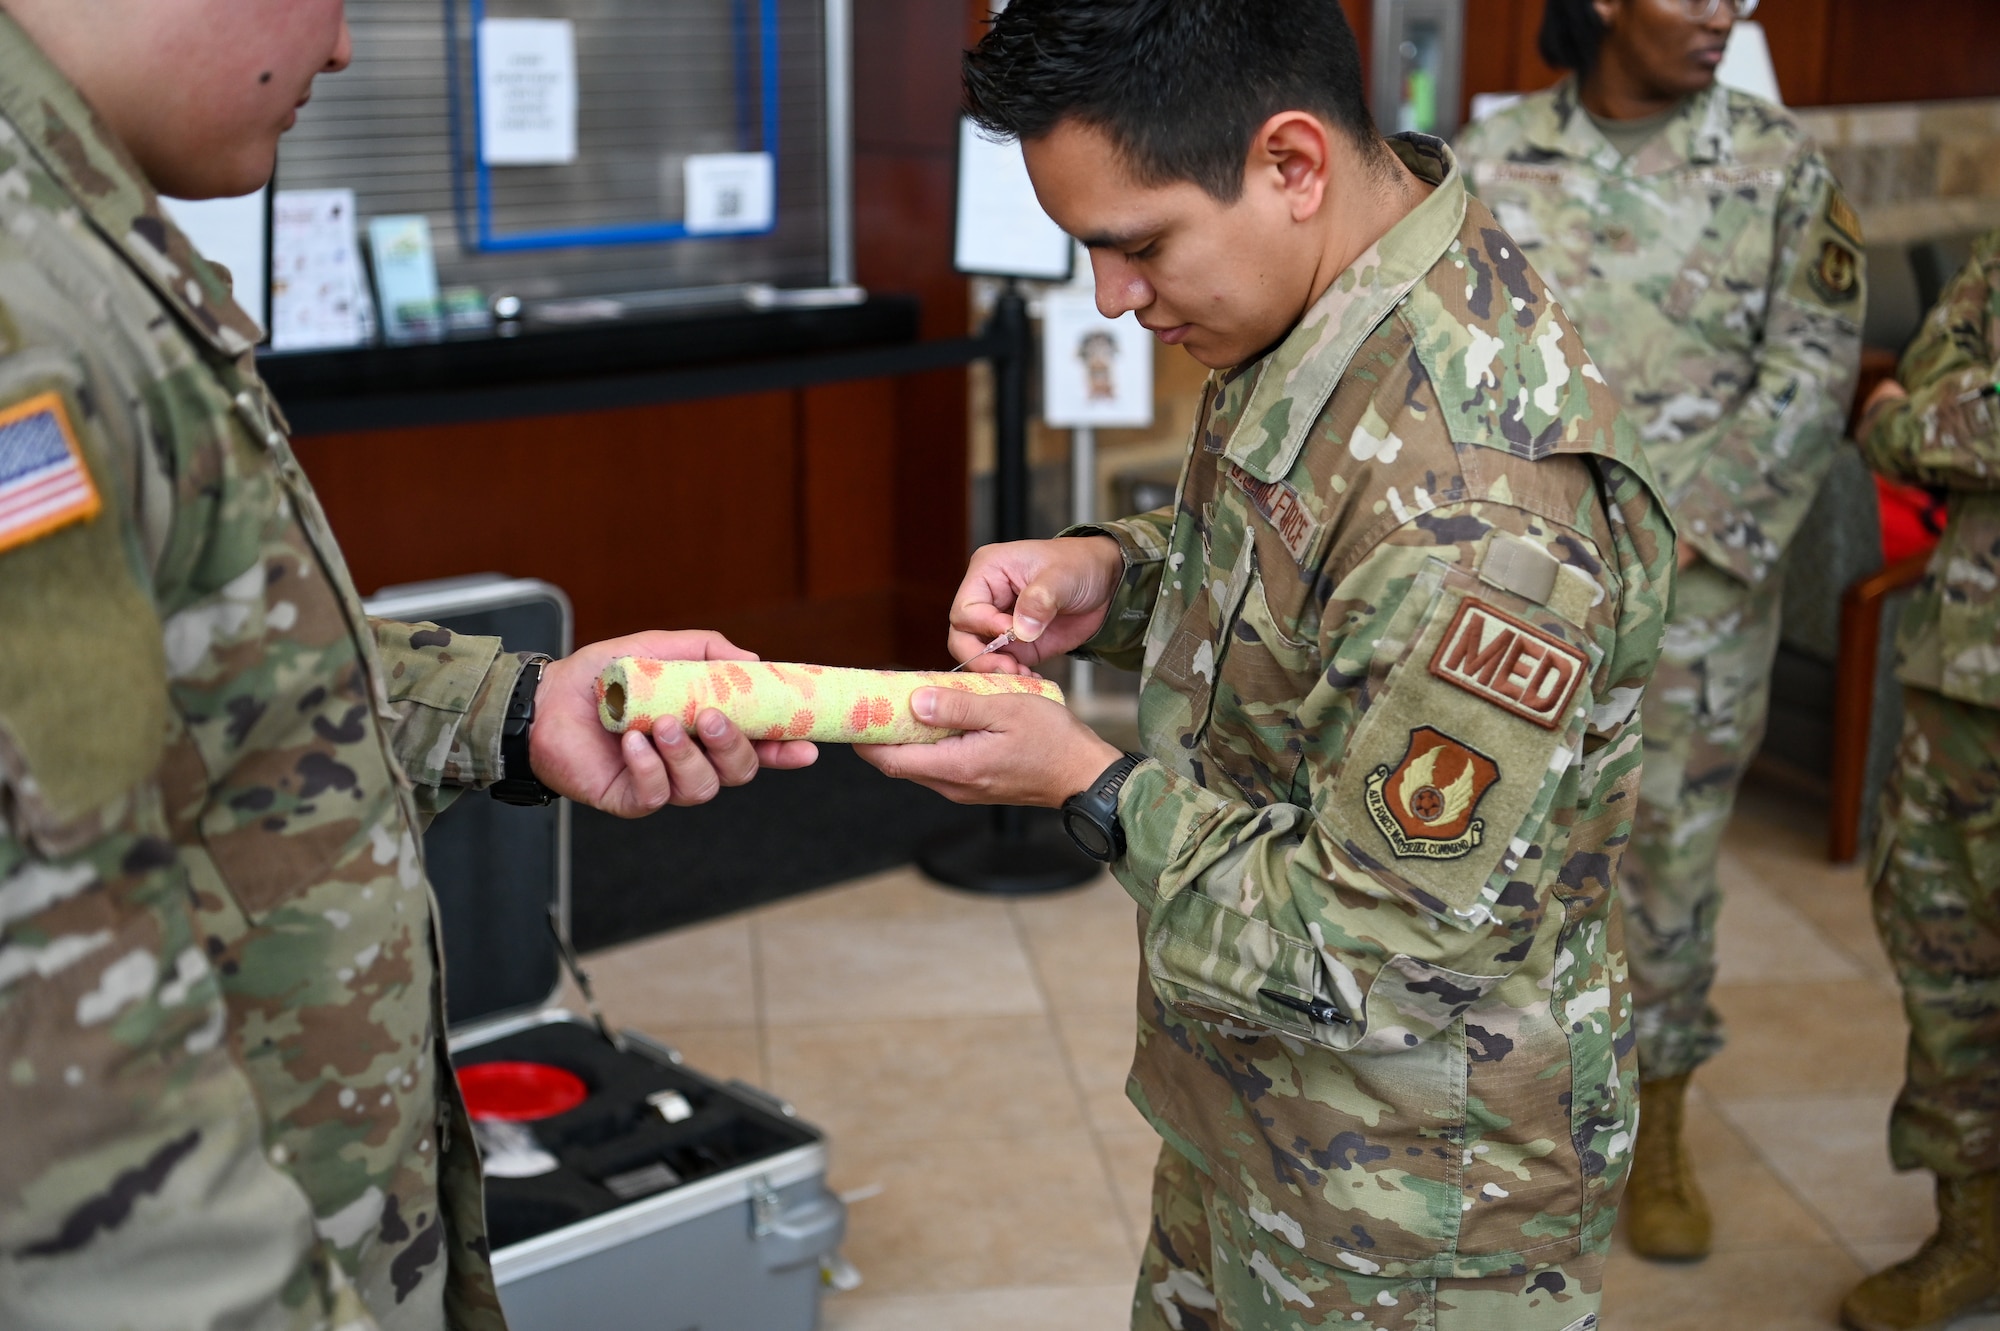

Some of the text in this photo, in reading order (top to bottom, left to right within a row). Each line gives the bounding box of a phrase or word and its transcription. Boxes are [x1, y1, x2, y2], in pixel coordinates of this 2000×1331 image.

[1270, 489, 1309, 552] FORCE
[1445, 613, 1574, 713] MED
[1368, 788, 1381, 807] AIR
[1373, 804, 1397, 834] FORCE
[1428, 839, 1470, 855] COMMAND
